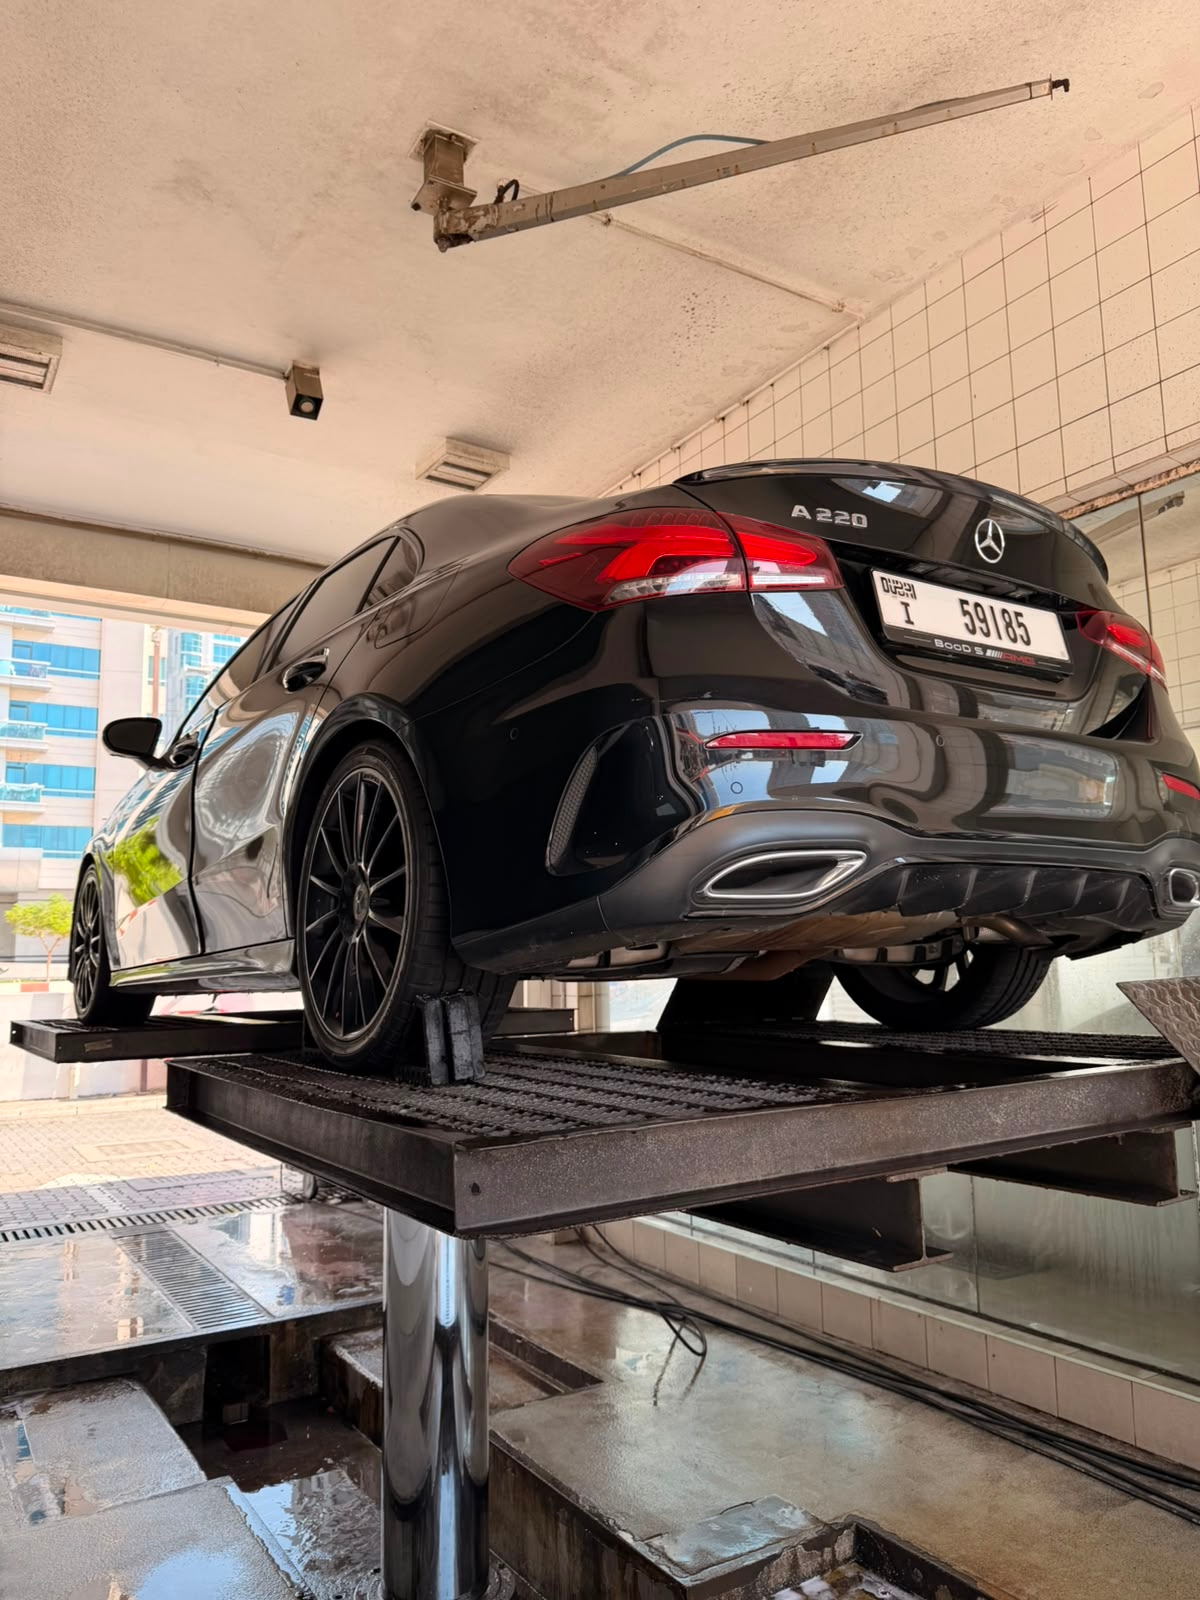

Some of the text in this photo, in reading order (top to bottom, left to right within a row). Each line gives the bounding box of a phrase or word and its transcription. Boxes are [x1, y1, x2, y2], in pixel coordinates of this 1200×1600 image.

[791, 504, 868, 529] A 220
[900, 598, 1031, 646] I 59185
